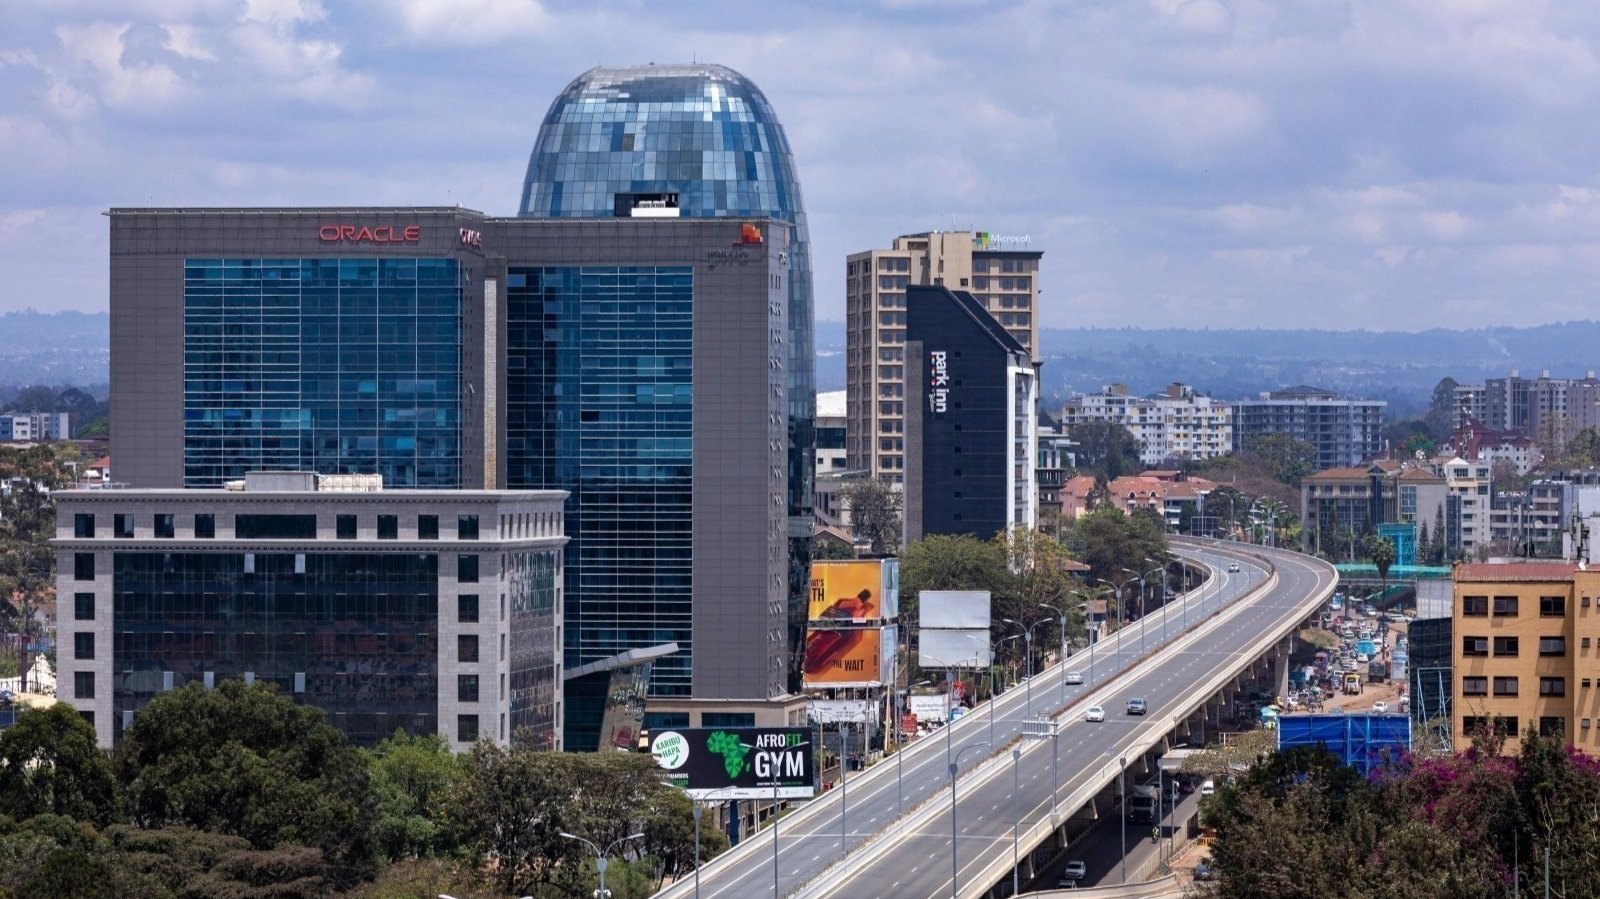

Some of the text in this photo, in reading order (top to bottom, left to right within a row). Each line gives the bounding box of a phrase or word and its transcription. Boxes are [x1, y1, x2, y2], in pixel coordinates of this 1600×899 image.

[319, 225, 420, 242] ORACLE
[990, 234, 1031, 243] Microsoft
[931, 351, 950, 386] park
[936, 388, 950, 412] inn
[809, 588, 825, 602] TH
[833, 660, 864, 671] THE WAIT
[655, 736, 681, 751] KARIBU
[756, 733, 802, 748] AFROFIT
[662, 746, 681, 758] HAPA
[755, 751, 804, 777] GYM
